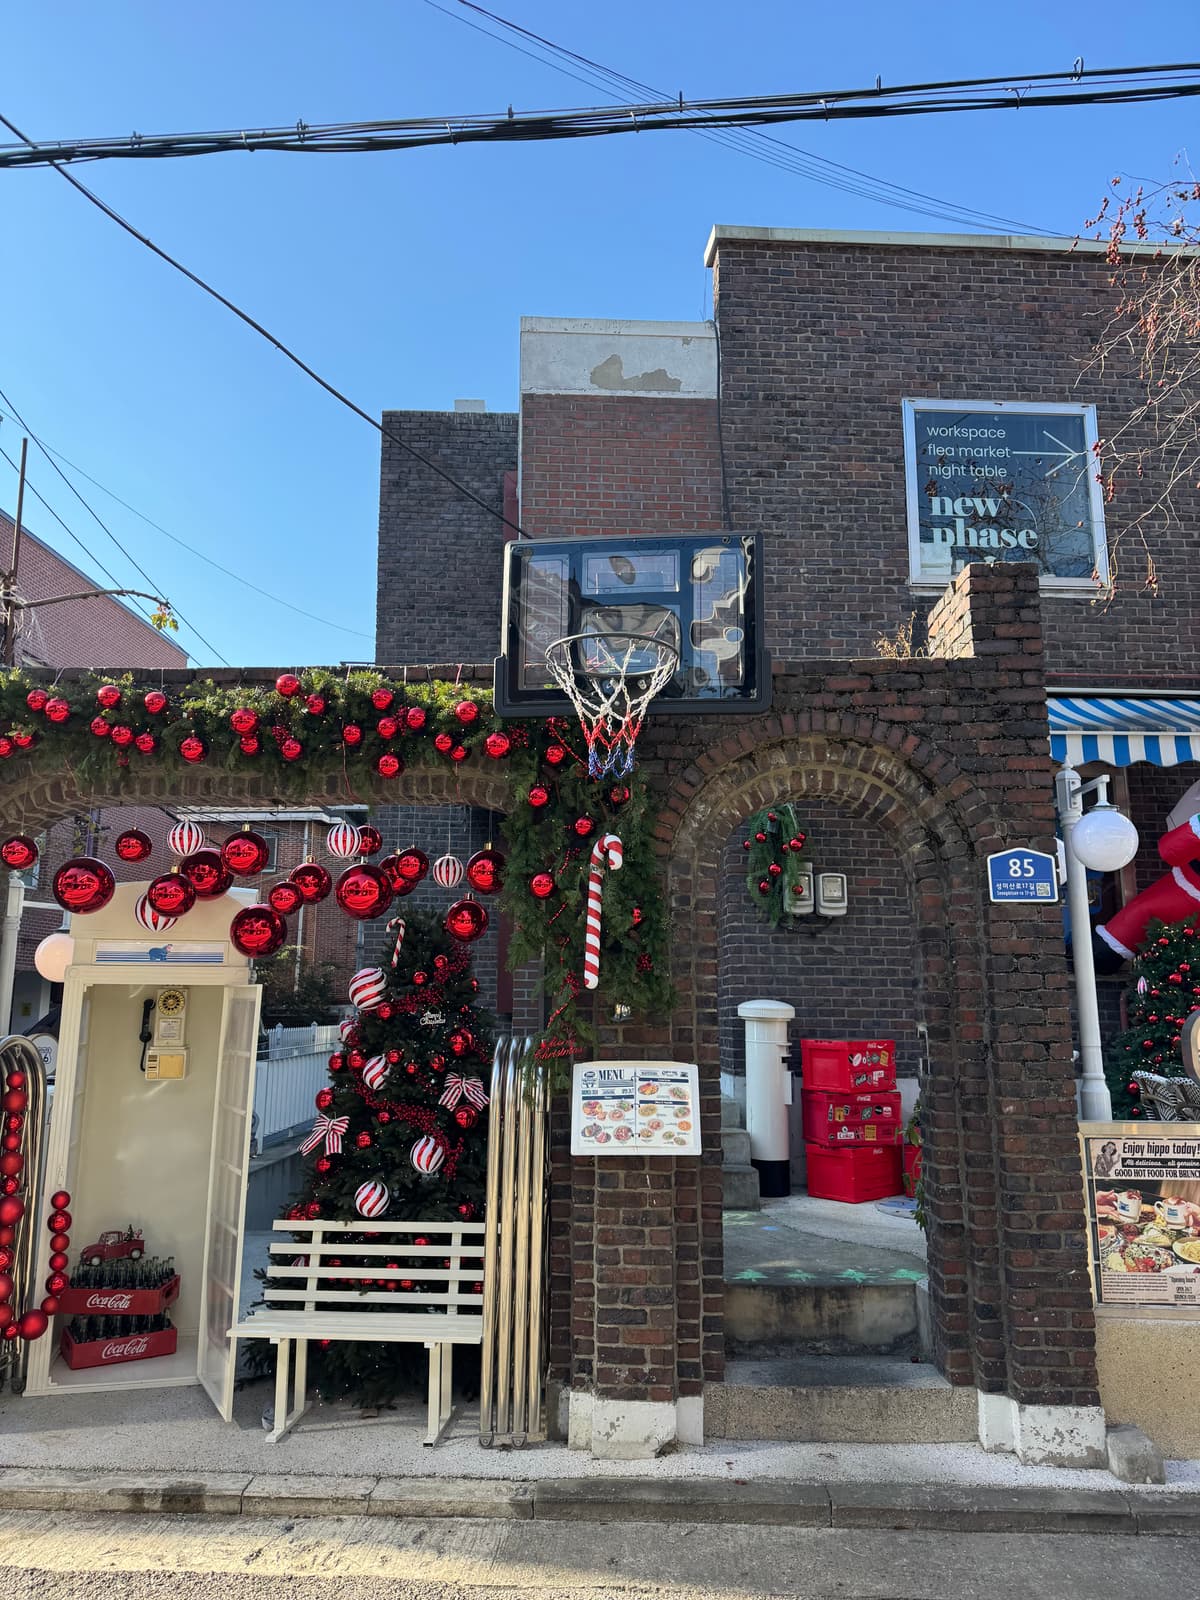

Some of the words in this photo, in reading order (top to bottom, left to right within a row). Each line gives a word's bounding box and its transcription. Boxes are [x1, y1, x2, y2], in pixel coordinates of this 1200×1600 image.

[926, 425, 1006, 440] workspace
[927, 444, 955, 457] flea
[958, 444, 1011, 458] market
[928, 464, 966, 479] night
[969, 464, 1007, 478] table
[930, 495, 1002, 517] new
[931, 518, 1038, 551] phase
[1008, 858, 1035, 877] 85
[996, 882, 1035, 890] 성미산로17길
[598, 1069, 625, 1081] MENU
[1122, 1141, 1145, 1156] Enjoy
[1147, 1141, 1170, 1157] hippo
[1172, 1141, 1200, 1157] today!
[1114, 1168, 1133, 1178] GOOD
[1133, 1169, 1147, 1178] HOT
[1147, 1169, 1165, 1178] FOOD
[1165, 1170, 1178, 1178] FOR
[1178, 1170, 1200, 1179] BRUNC
